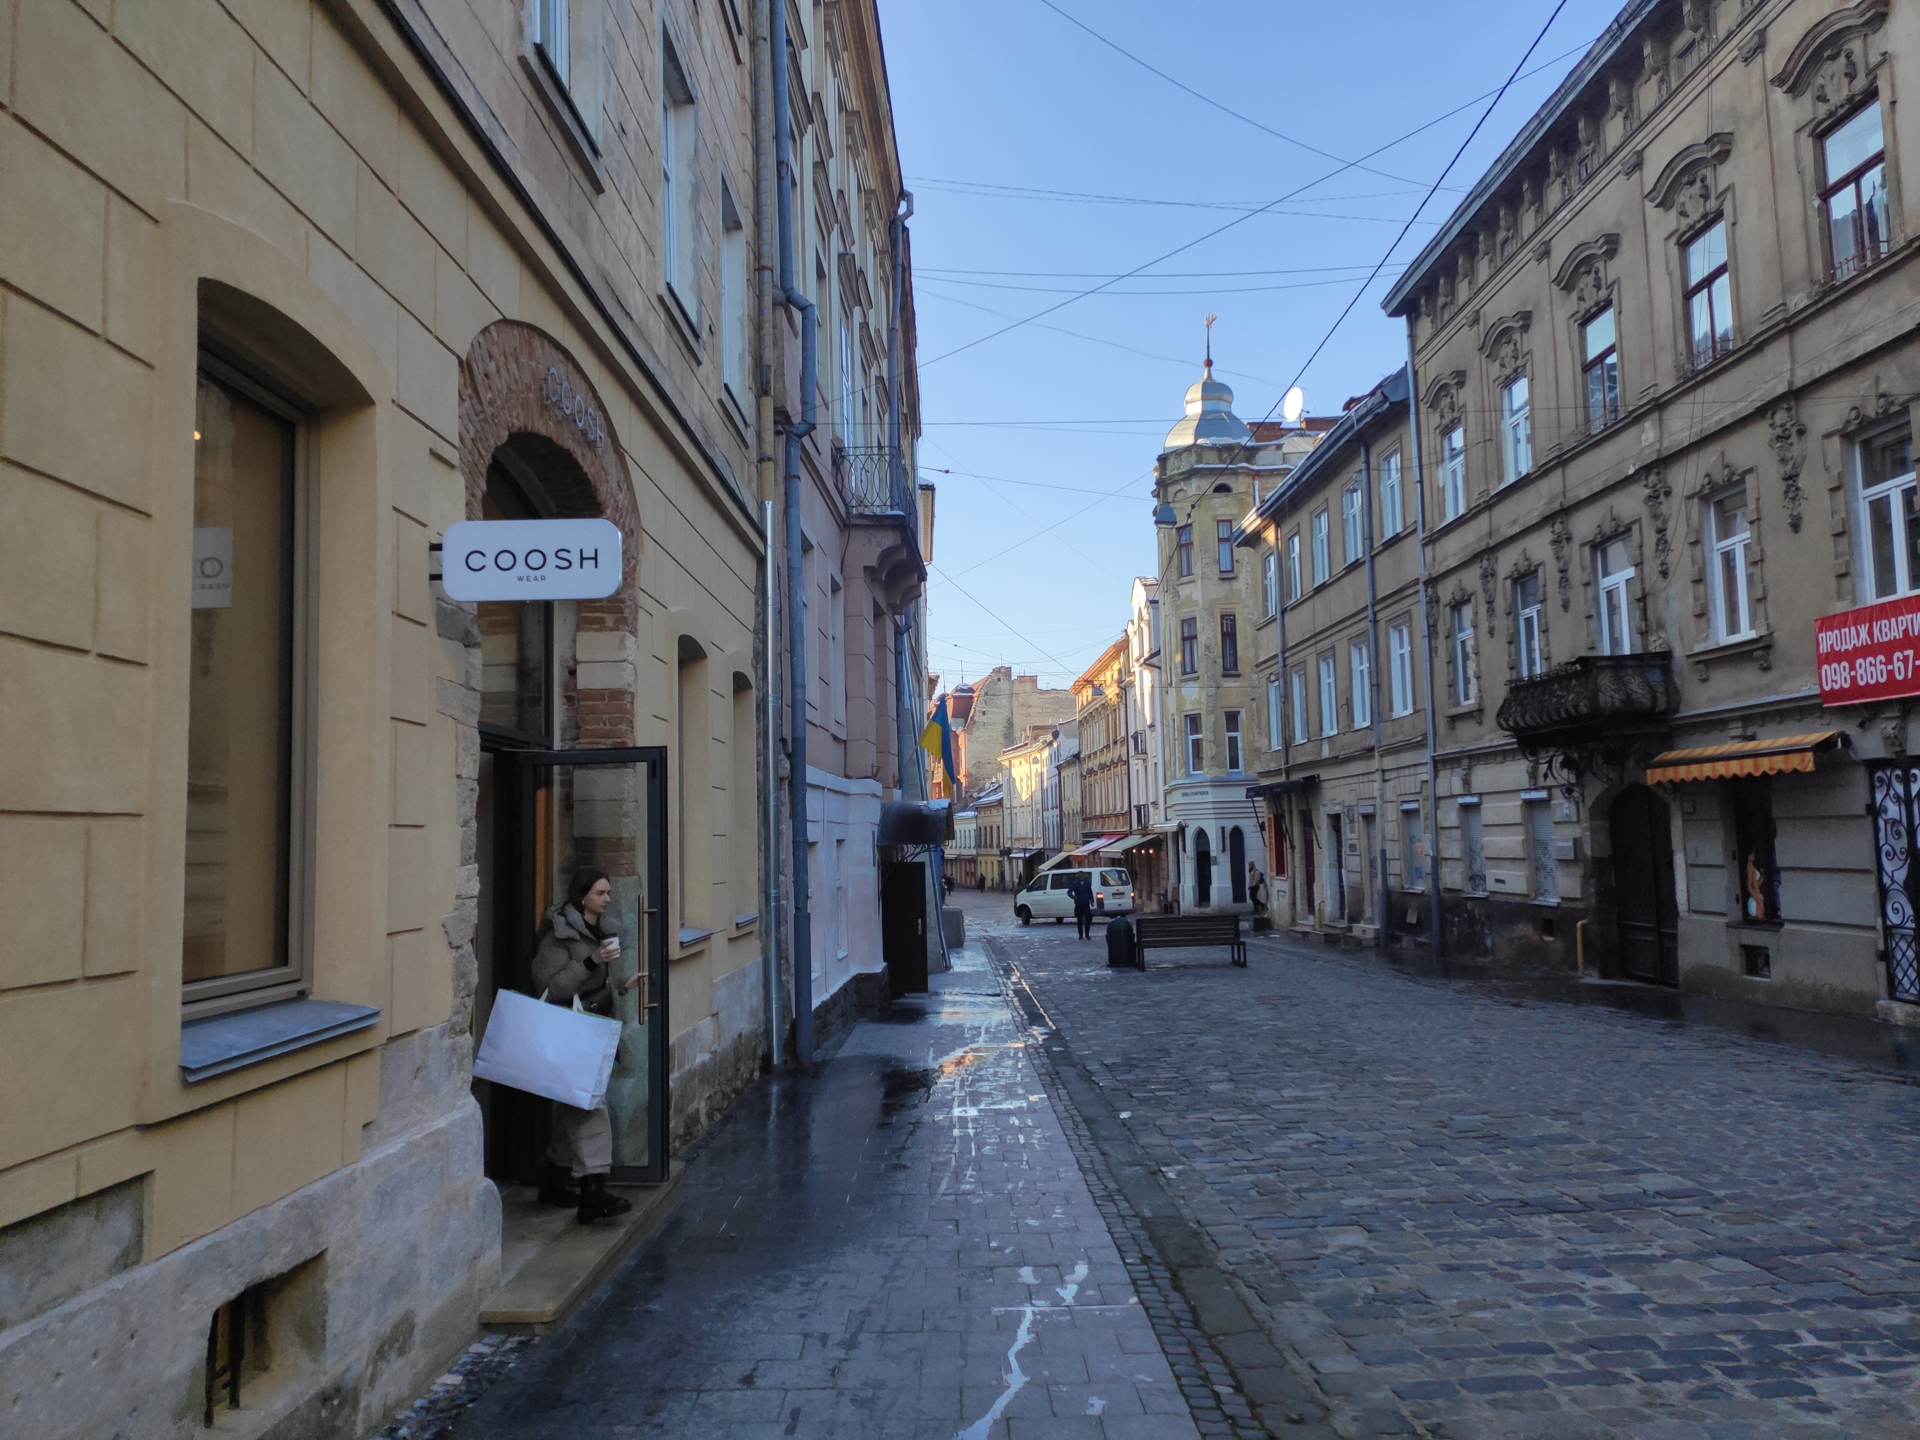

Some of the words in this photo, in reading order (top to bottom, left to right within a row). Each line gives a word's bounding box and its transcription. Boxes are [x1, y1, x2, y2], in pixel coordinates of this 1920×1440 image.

[547, 367, 605, 448] COOSH
[465, 548, 599, 572] COOSH
[1818, 624, 1871, 654] ПРОДАЖ
